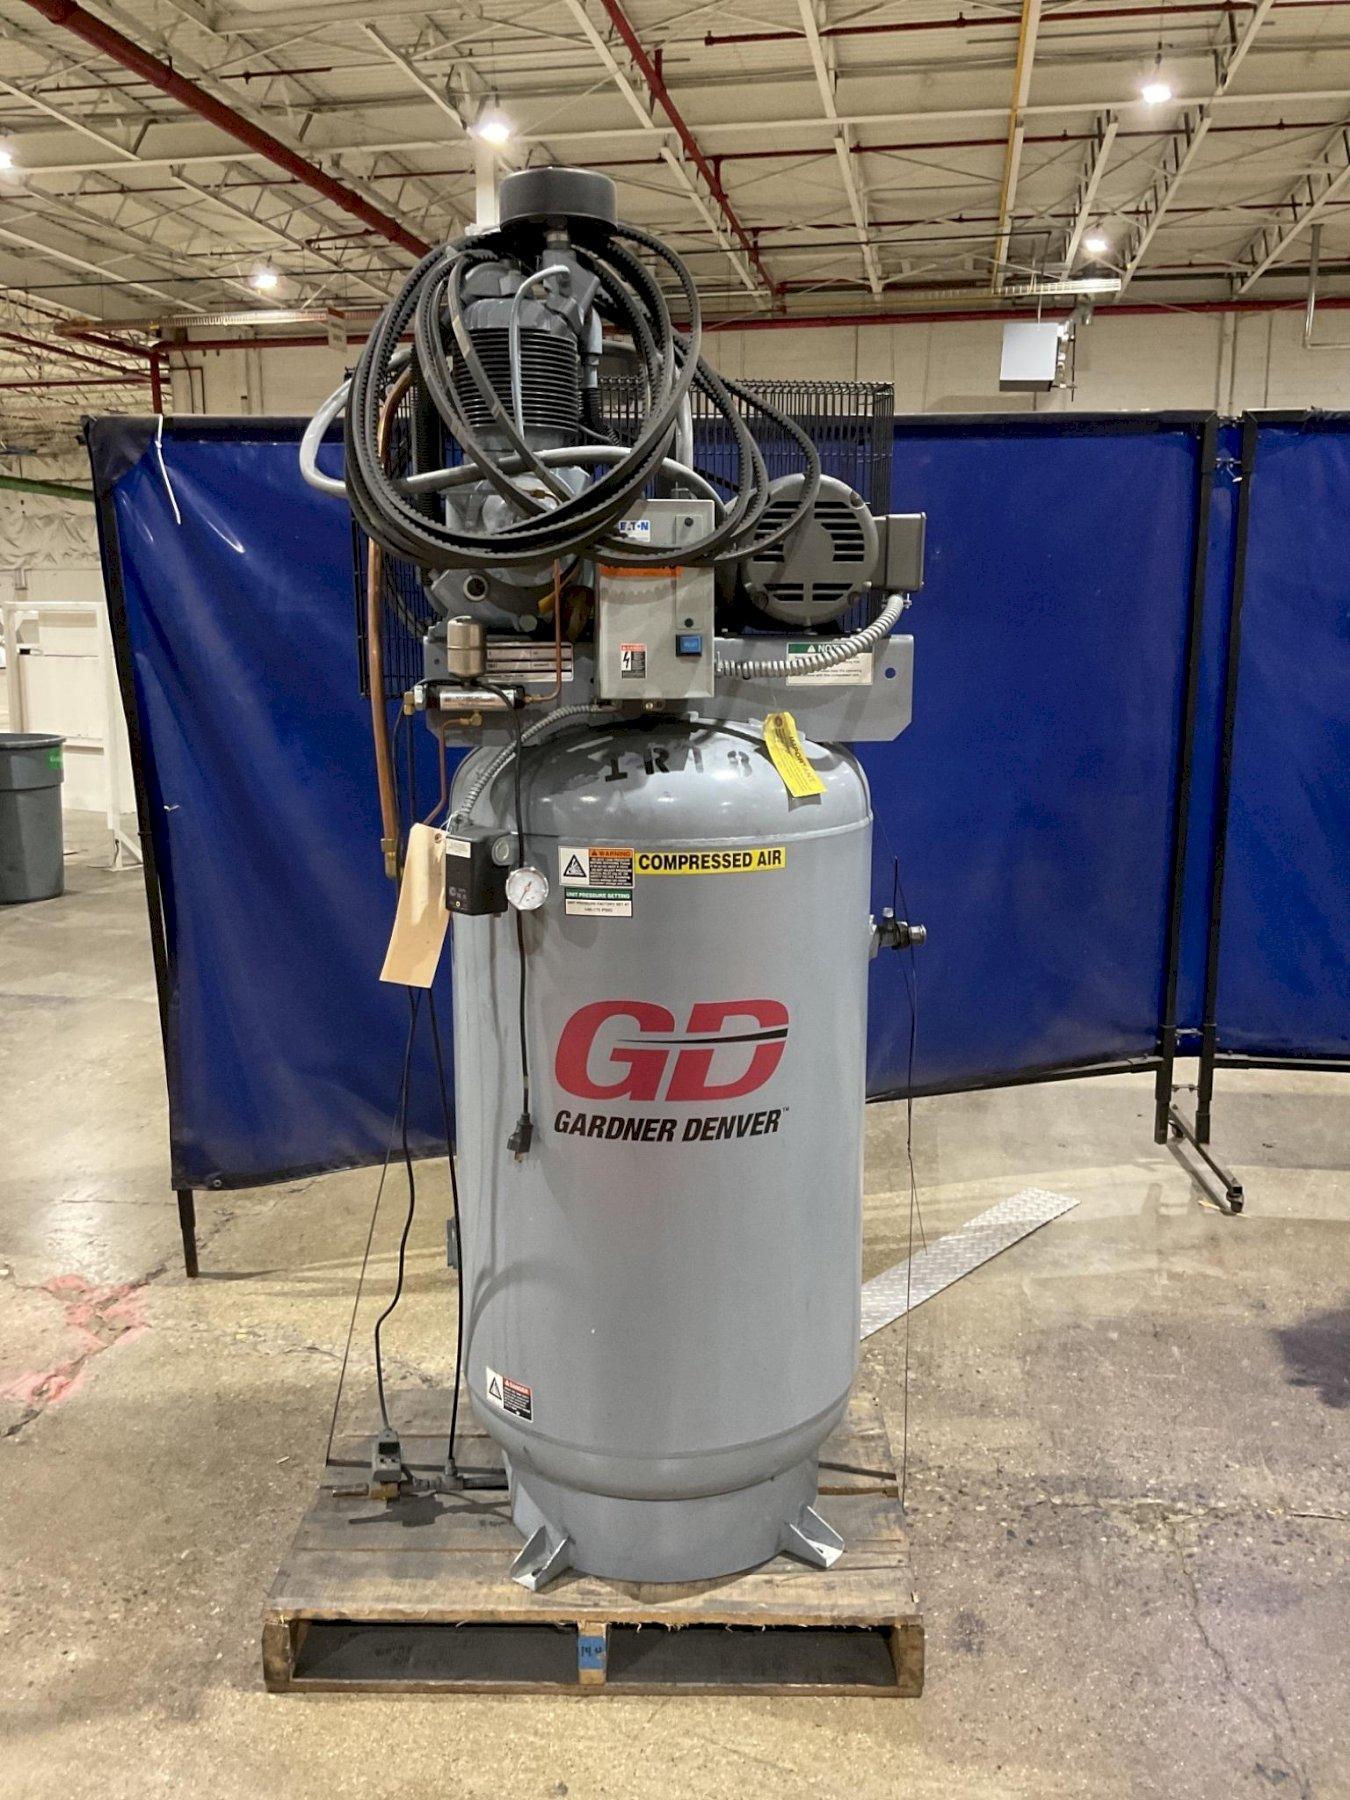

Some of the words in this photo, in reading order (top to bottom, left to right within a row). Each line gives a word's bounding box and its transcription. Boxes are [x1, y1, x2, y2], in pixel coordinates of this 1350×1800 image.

[638, 852, 753, 871] COMPRESSED
[757, 849, 782, 867] AIR
[555, 1000, 789, 1102] GD
[554, 1109, 678, 1142] GARDNER
